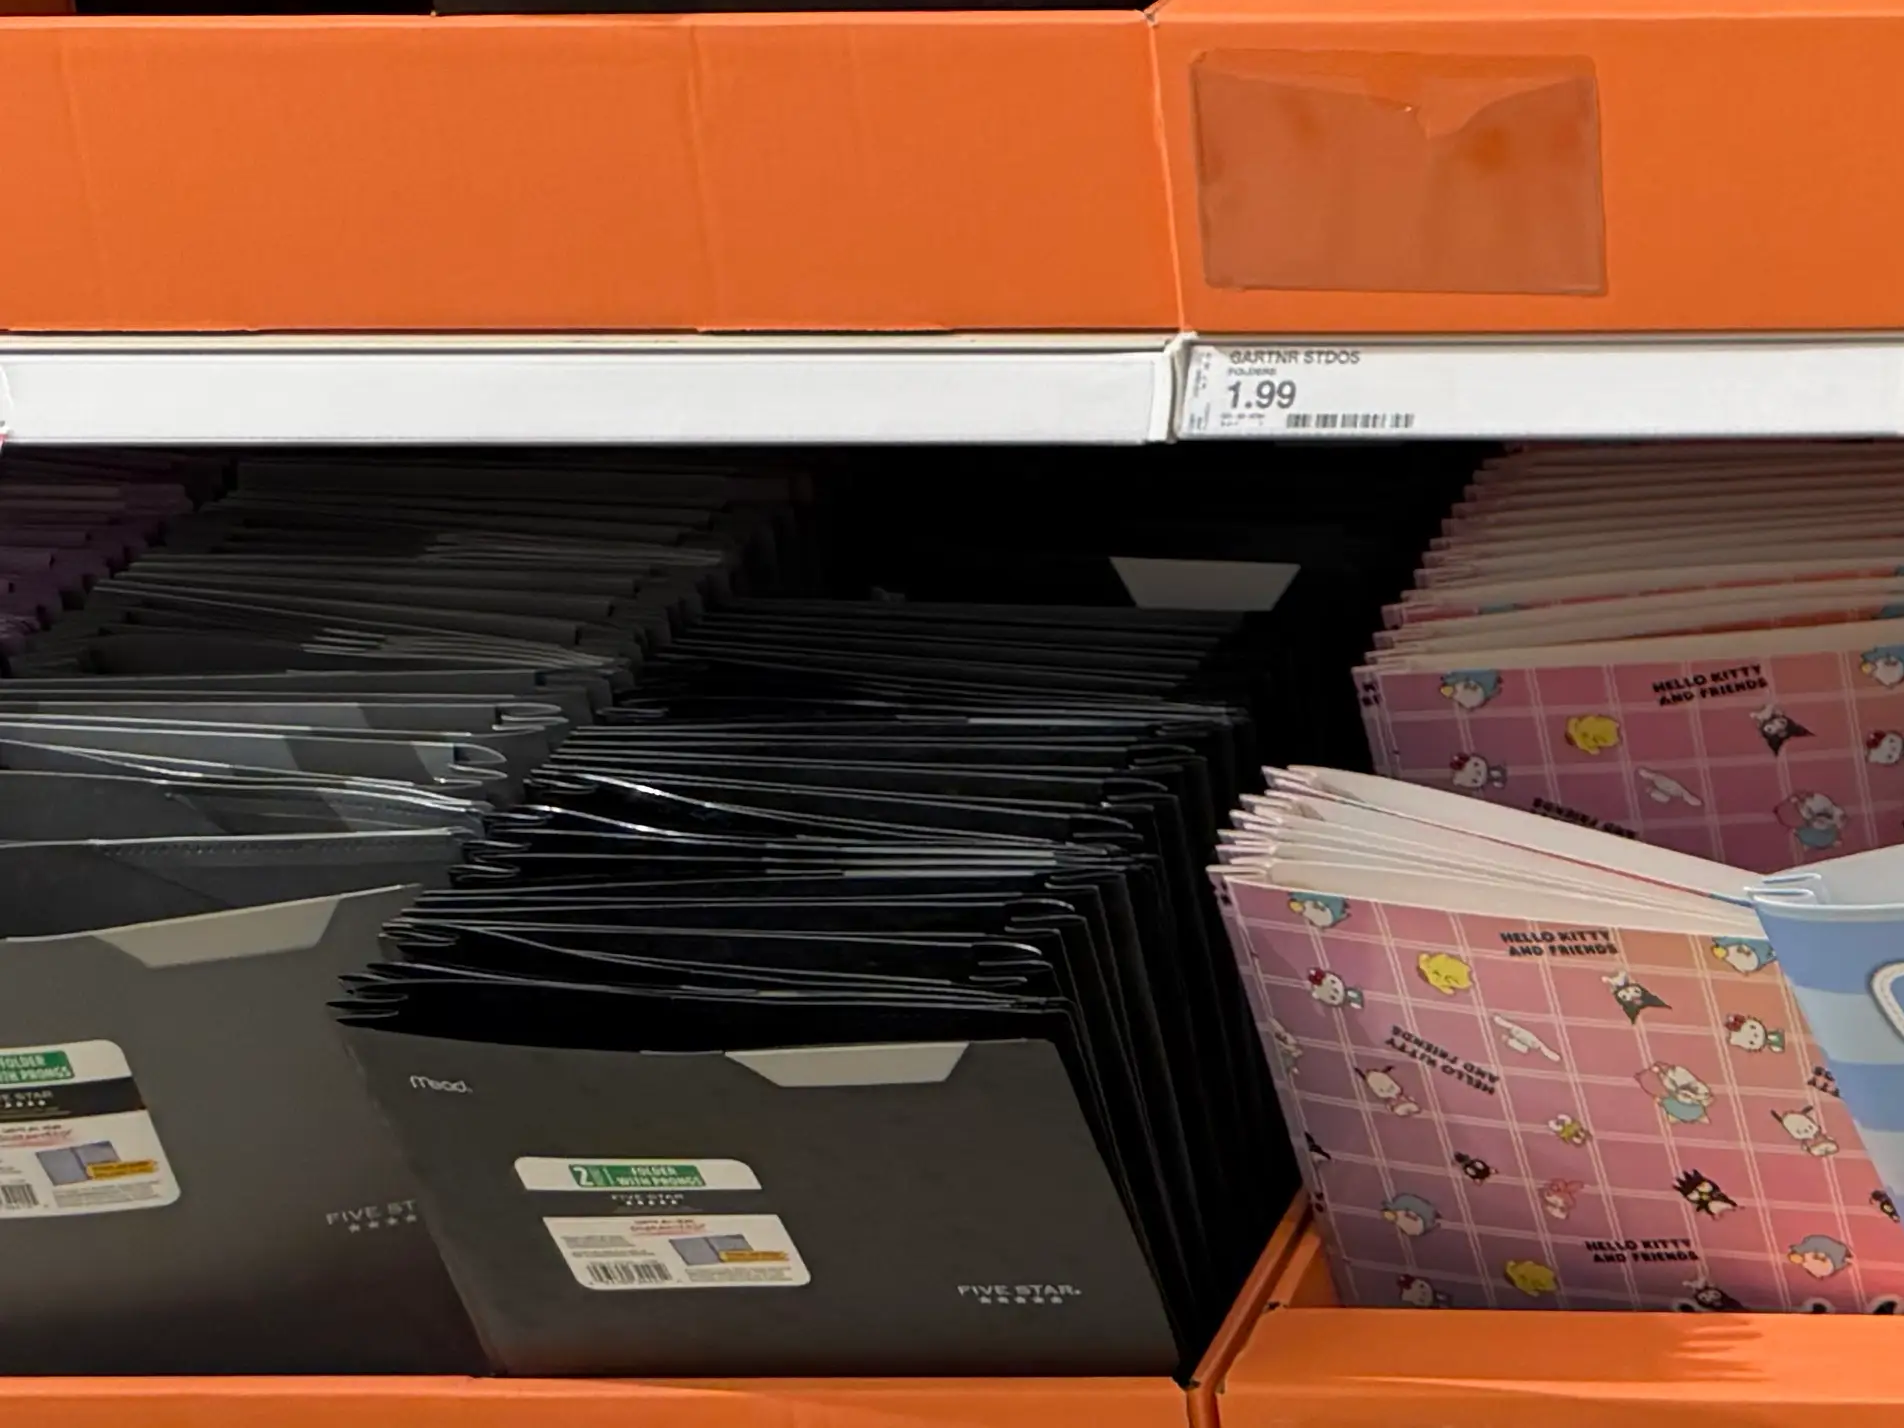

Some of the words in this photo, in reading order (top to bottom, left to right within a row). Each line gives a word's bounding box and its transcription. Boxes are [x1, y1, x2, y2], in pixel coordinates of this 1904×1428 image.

[1304, 350, 1360, 364] STDOS
[1228, 380, 1297, 409] 1.99
[1652, 674, 1707, 694] HELLO
[1710, 664, 1763, 684] KITTY
[1659, 689, 1695, 706] AND
[1698, 677, 1768, 699] FRIENDS
[1500, 930, 1555, 944] HELLO
[1558, 930, 1612, 943] KITTY
[1509, 943, 1543, 956] AND
[1549, 943, 1618, 956] FRIENDS
[572, 1166, 594, 1186] 2
[631, 1166, 676, 1176] FOLDER
[326, 1206, 381, 1225] FIVE
[1585, 1240, 1638, 1251] HELLO
[1641, 1238, 1691, 1249] KITTY
[1593, 1253, 1627, 1263] AND
[1631, 1251, 1699, 1262] FRIENDS
[957, 1285, 1012, 1296] FIVE
